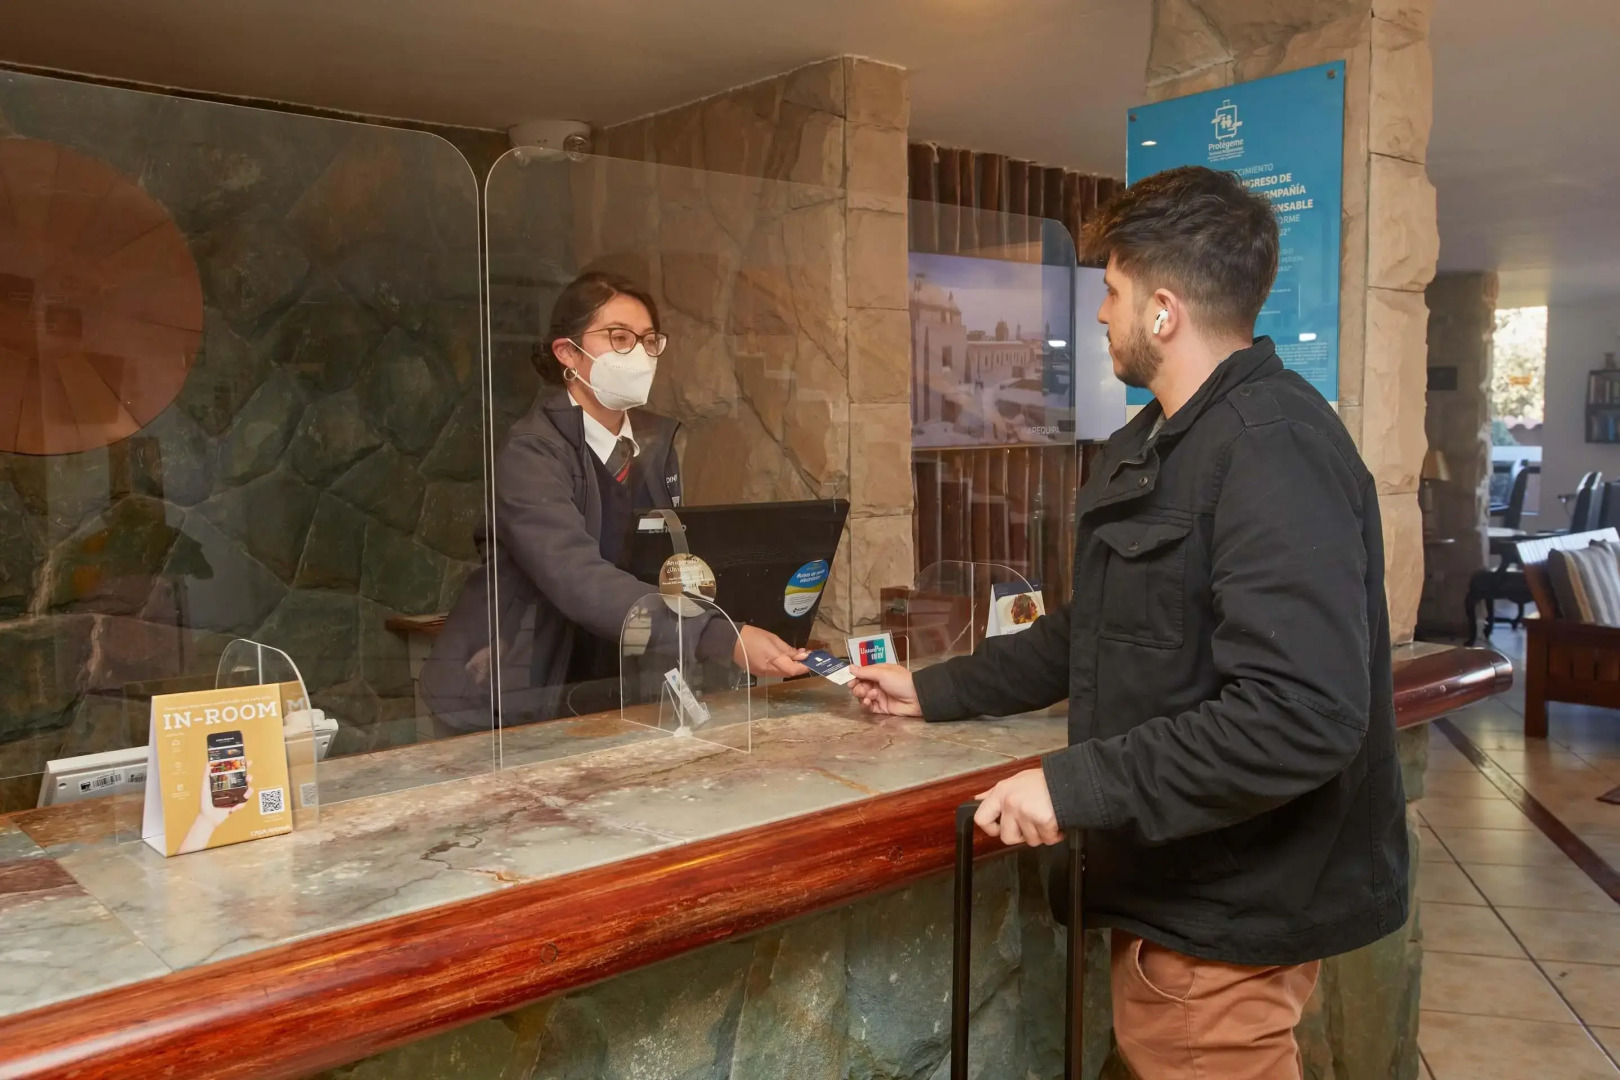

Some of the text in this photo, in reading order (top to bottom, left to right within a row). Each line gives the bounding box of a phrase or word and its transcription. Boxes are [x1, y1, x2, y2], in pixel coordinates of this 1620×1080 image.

[1209, 139, 1244, 150] Protégeme
[1279, 173, 1292, 183] DE
[1028, 426, 1060, 435] AREQUIPA
[163, 701, 278, 730] IN-ROOM
